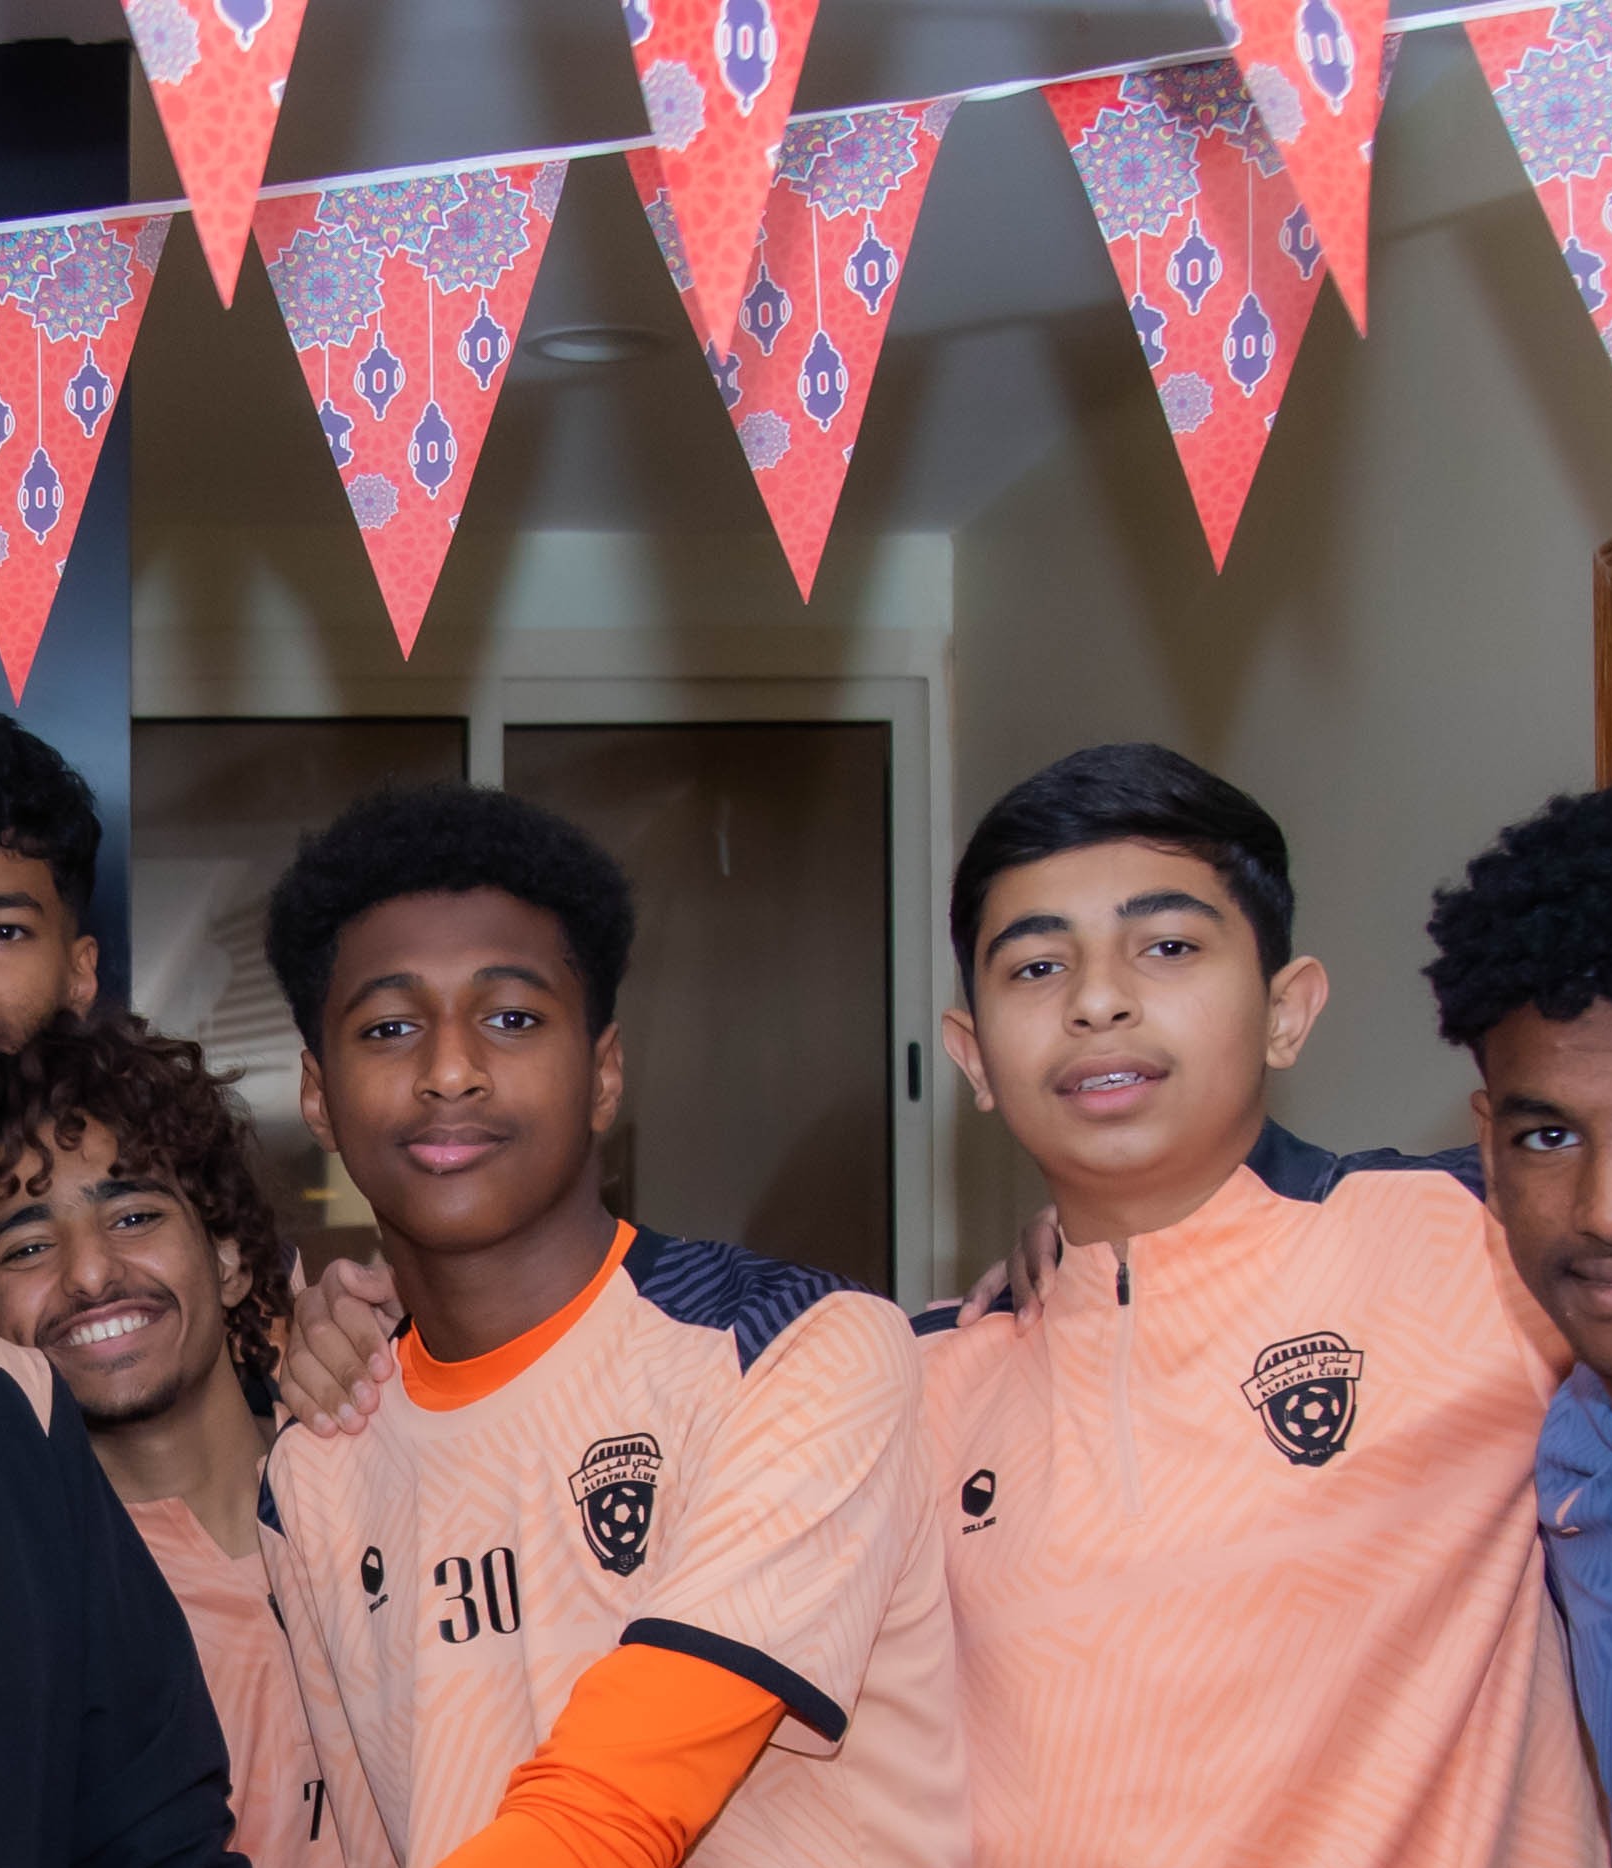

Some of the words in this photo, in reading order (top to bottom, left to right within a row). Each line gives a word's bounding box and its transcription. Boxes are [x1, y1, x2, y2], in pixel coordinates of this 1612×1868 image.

[581, 1455, 631, 1483] الفيحاء
[631, 1470, 657, 1483] CLUB
[433, 1546, 521, 1644] 30
